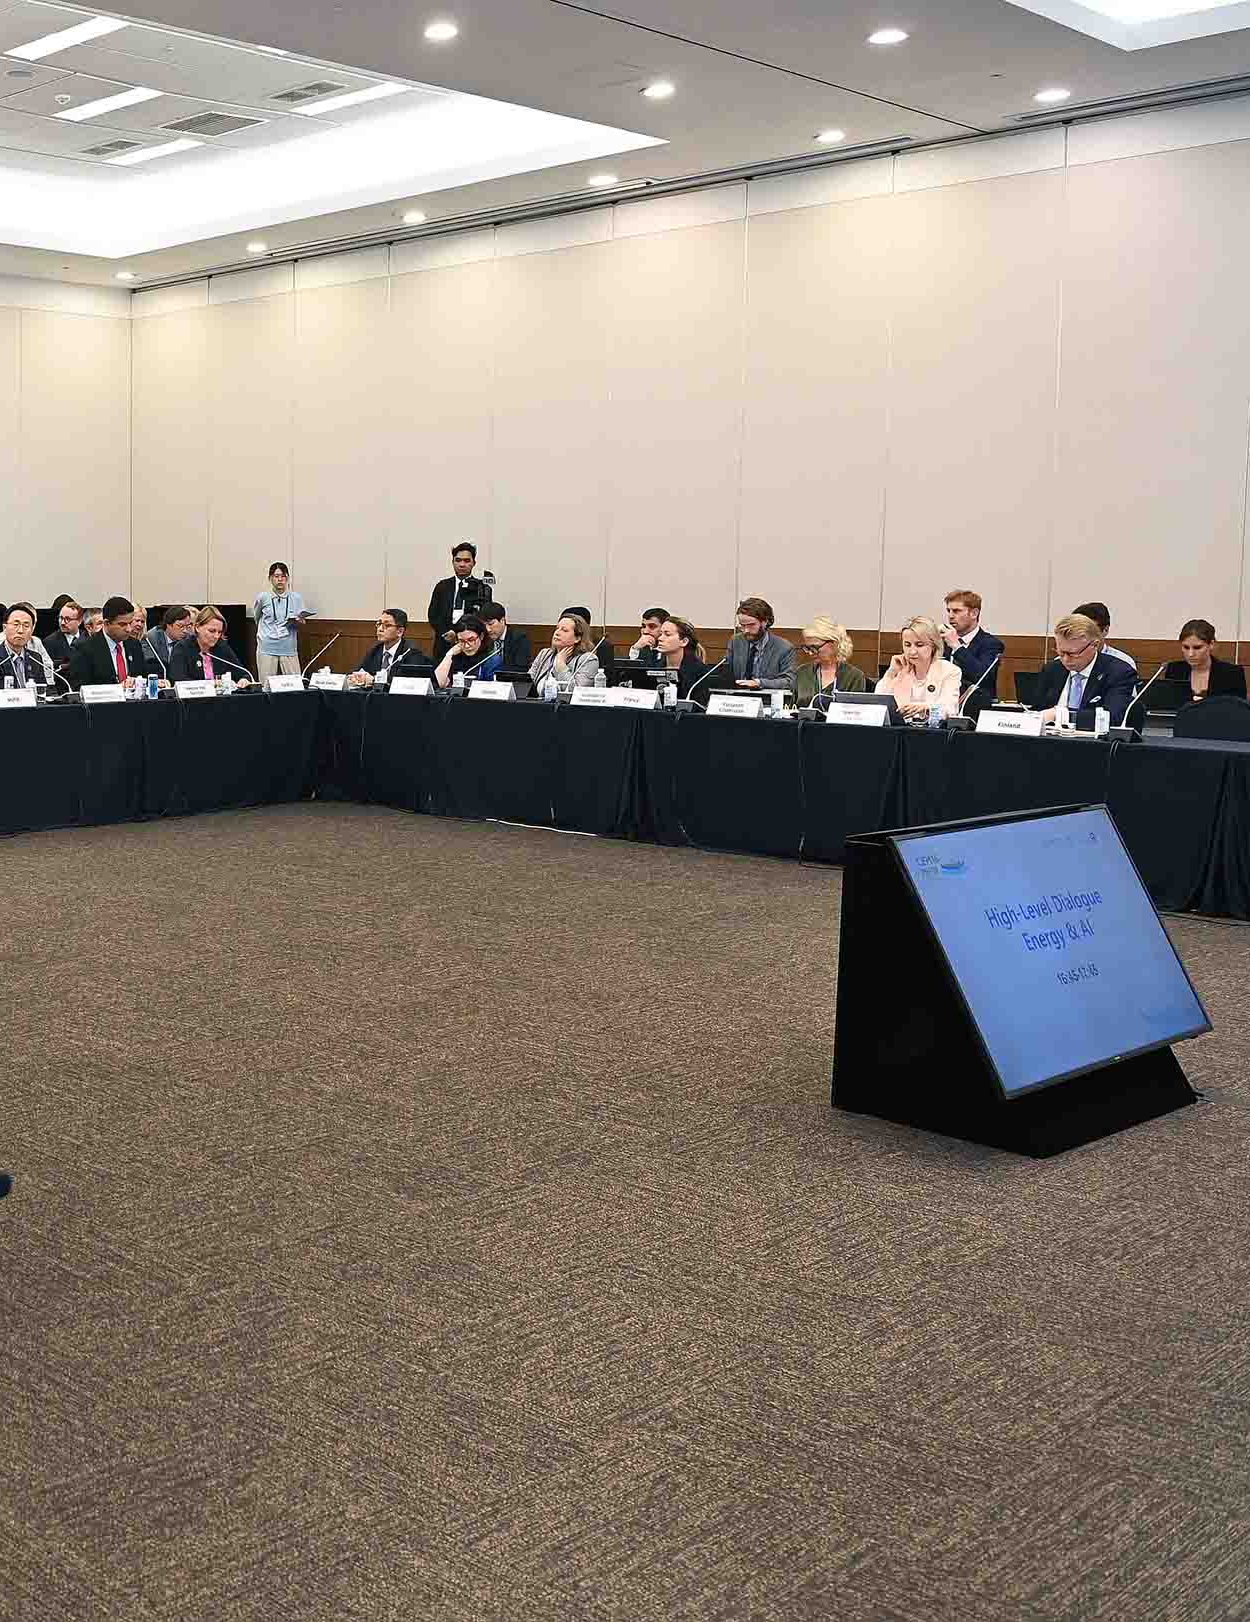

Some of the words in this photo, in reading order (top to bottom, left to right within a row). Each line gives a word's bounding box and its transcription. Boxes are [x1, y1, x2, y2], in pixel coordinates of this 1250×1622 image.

[997, 721, 1021, 729] Finland
[985, 896, 1052, 930] High-Level
[1050, 890, 1102, 912] Dialogue
[1022, 927, 1067, 951] Energy
[1065, 922, 1079, 940] &
[1079, 919, 1095, 937] AI
